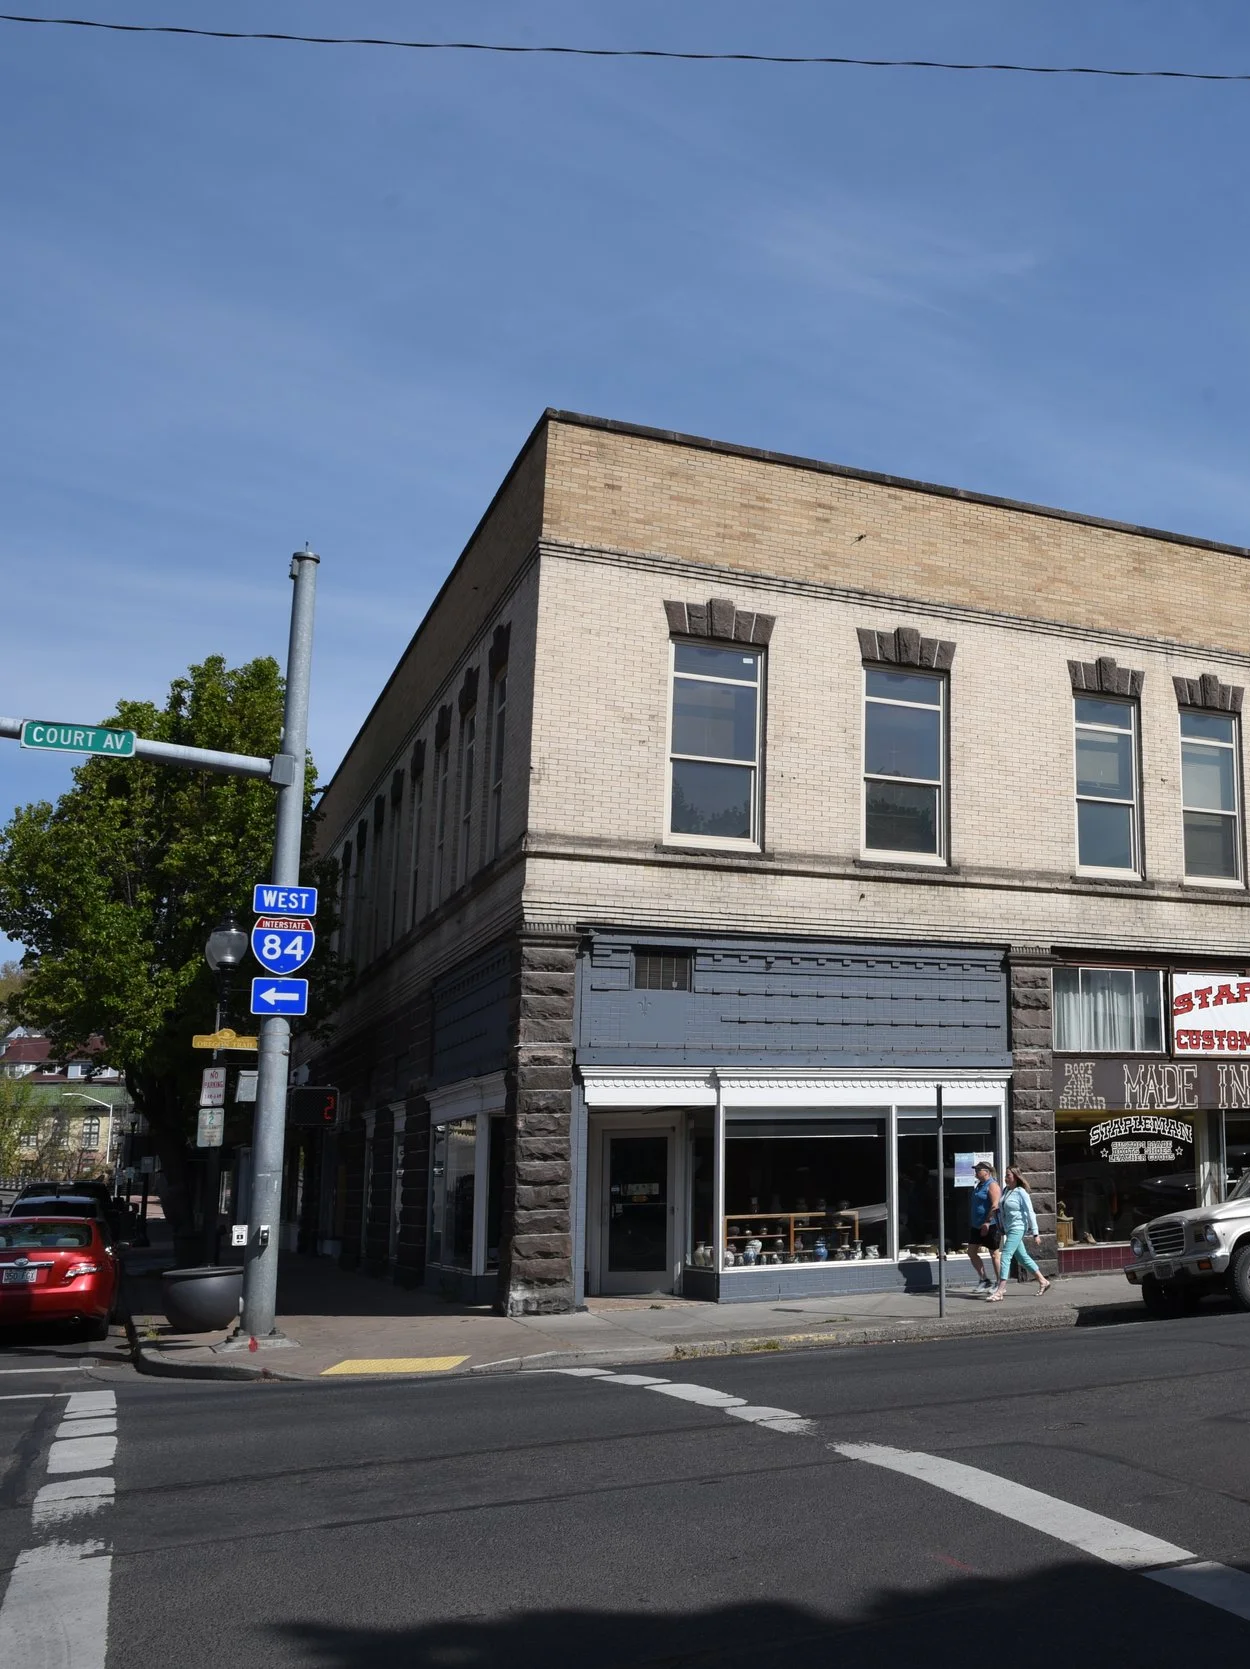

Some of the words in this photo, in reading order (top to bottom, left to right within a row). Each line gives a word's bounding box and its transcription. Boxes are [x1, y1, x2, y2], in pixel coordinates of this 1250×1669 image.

[33, 727, 96, 747] COURT
[103, 734, 125, 749] AV
[263, 890, 309, 909] WEST
[262, 920, 306, 930] INTERSTATE
[262, 934, 304, 961] 84
[210, 1071, 218, 1079] NO
[1064, 1062, 1096, 1076] BOOT
[1067, 1074, 1093, 1086] AND
[1063, 1085, 1094, 1097] SHOE
[1123, 1064, 1198, 1110] MADE
[1059, 1096, 1106, 1110] REPAIR
[208, 1115, 214, 1124] 2
[1089, 1115, 1193, 1147] STAPLEMAN
[1111, 1140, 1146, 1148] CUSTOM
[1146, 1140, 1173, 1148] MADE
[1111, 1147, 1140, 1155] BOOTS
[1144, 1147, 1172, 1155] SHOES
[1108, 1154, 1146, 1162] LEATHER
[1147, 1153, 1175, 1161] GOODS
